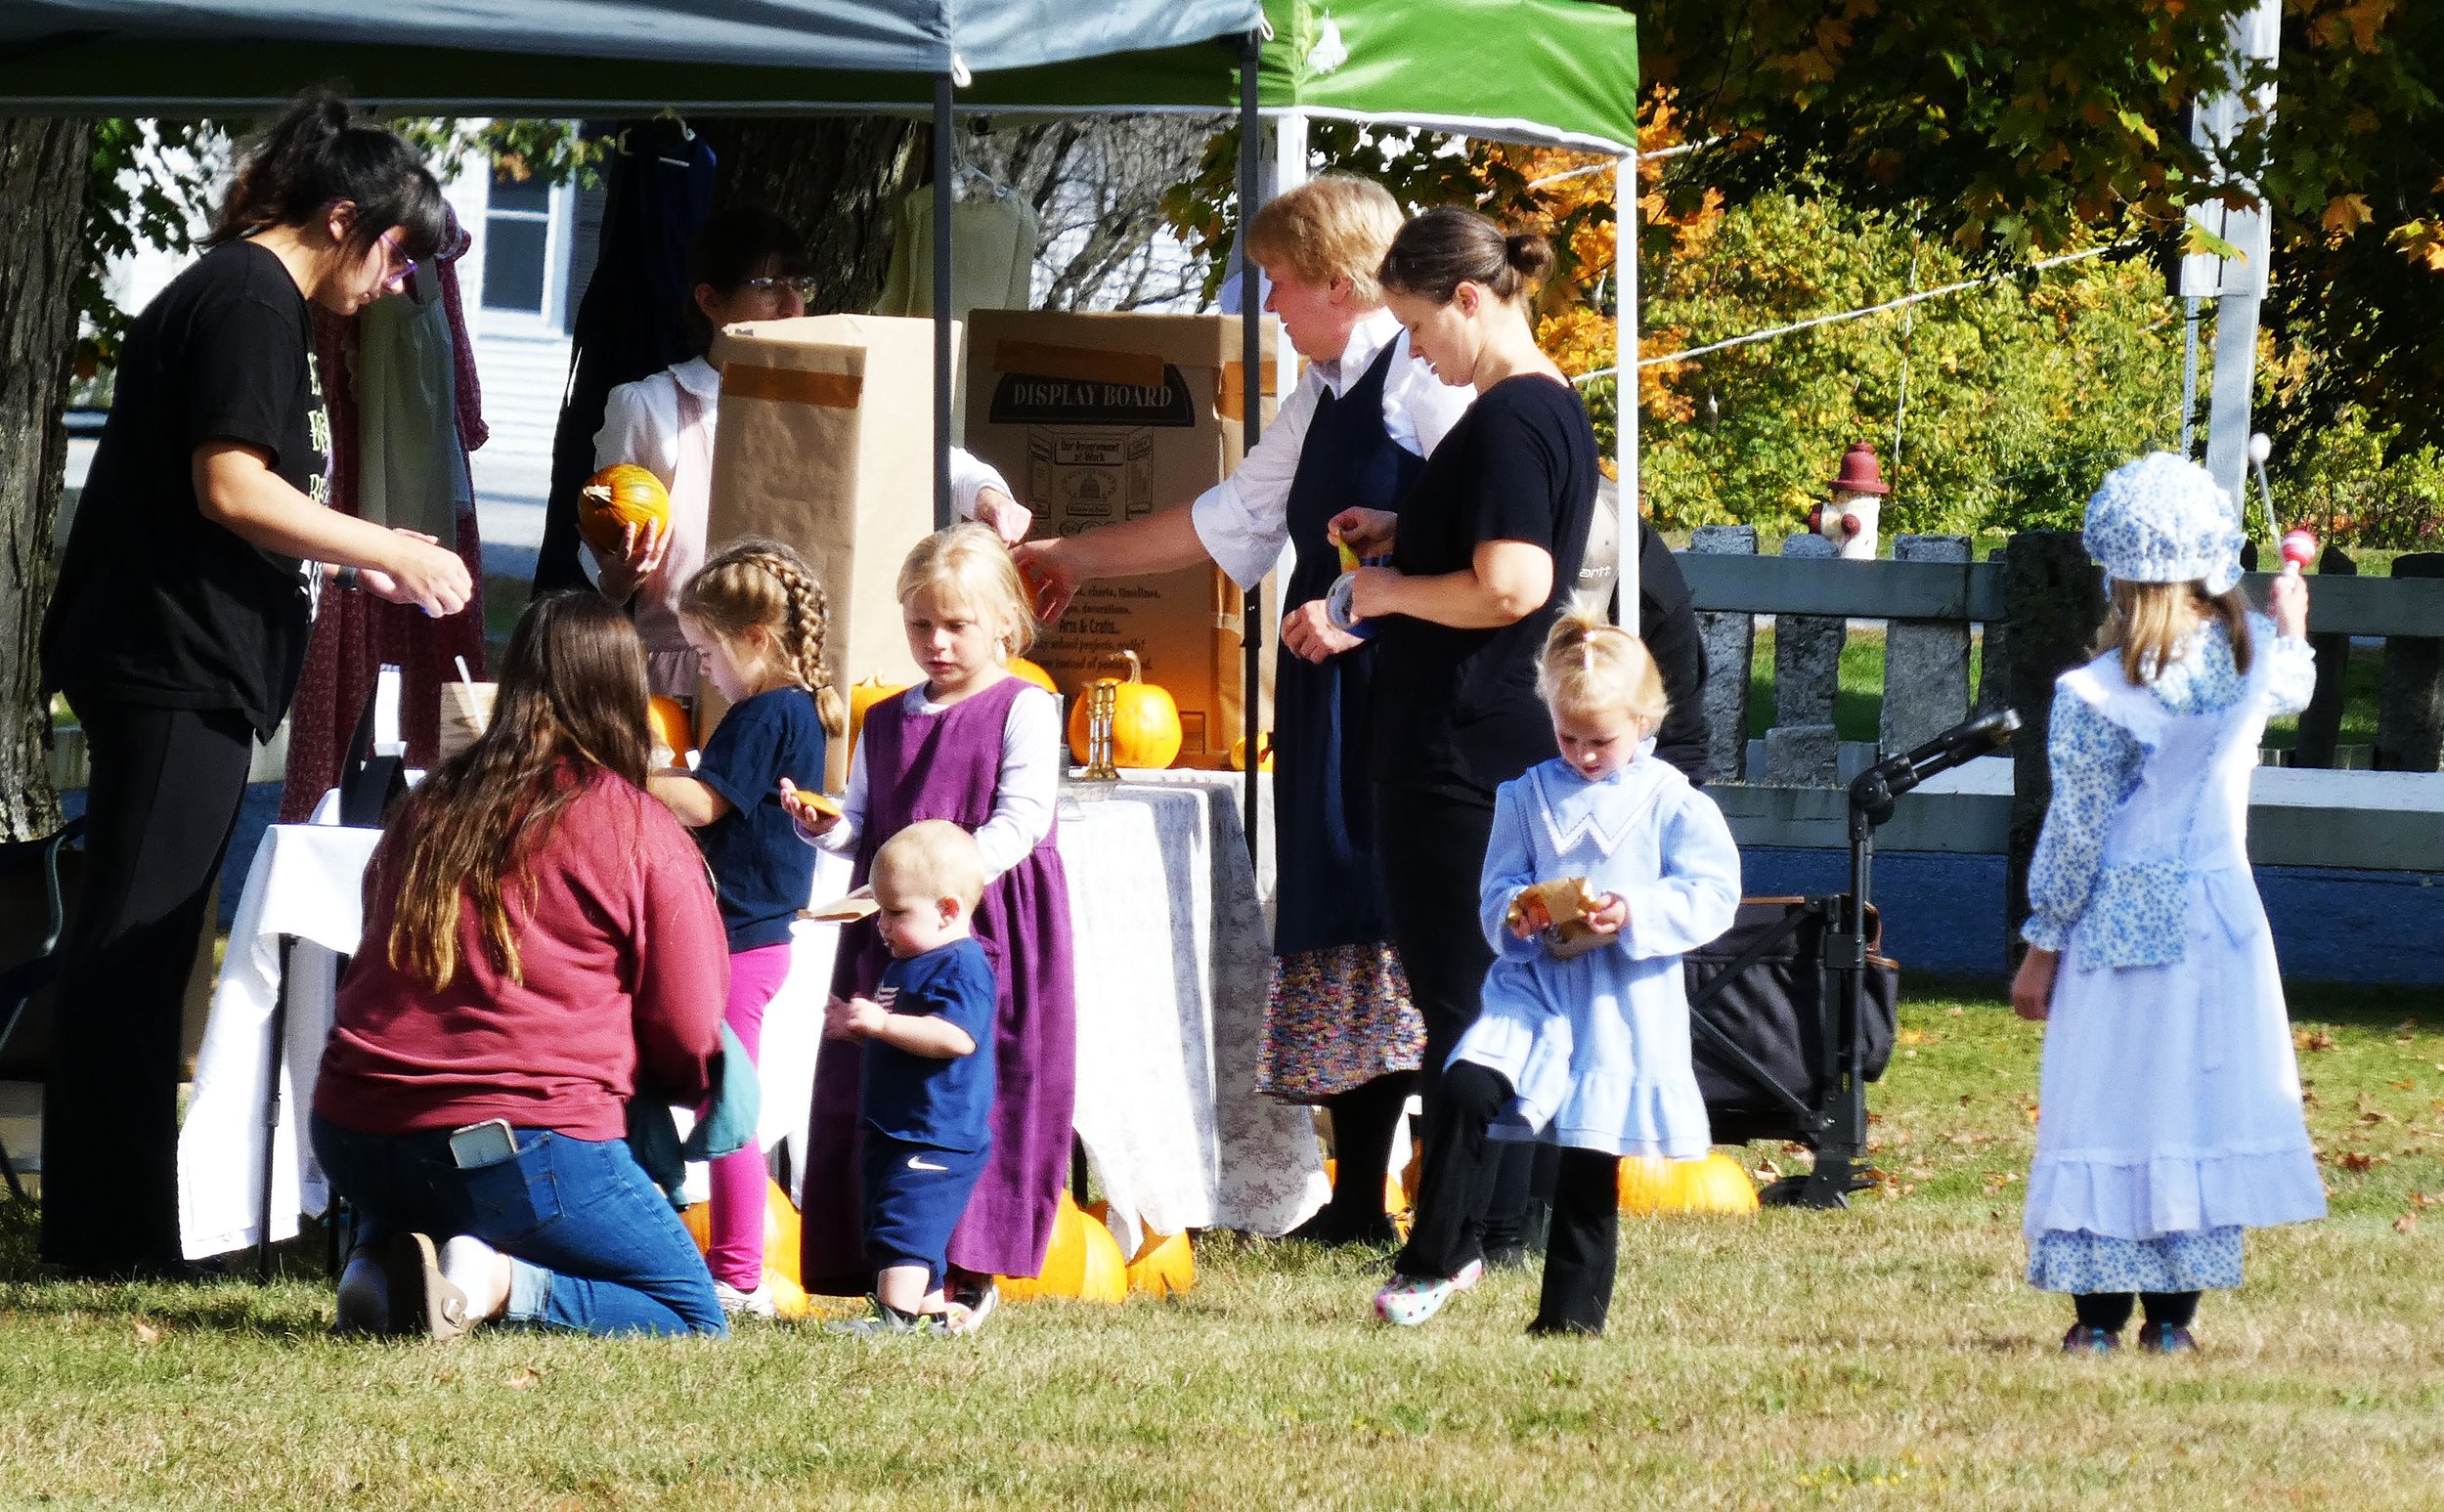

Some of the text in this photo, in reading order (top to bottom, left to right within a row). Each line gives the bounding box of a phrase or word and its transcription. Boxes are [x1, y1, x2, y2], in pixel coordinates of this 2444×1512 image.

[1014, 382, 1173, 408] DISPLAY BOARD
[1085, 452, 1105, 461] Work
[1059, 619, 1077, 633] Arts
[1079, 619, 1087, 633] &
